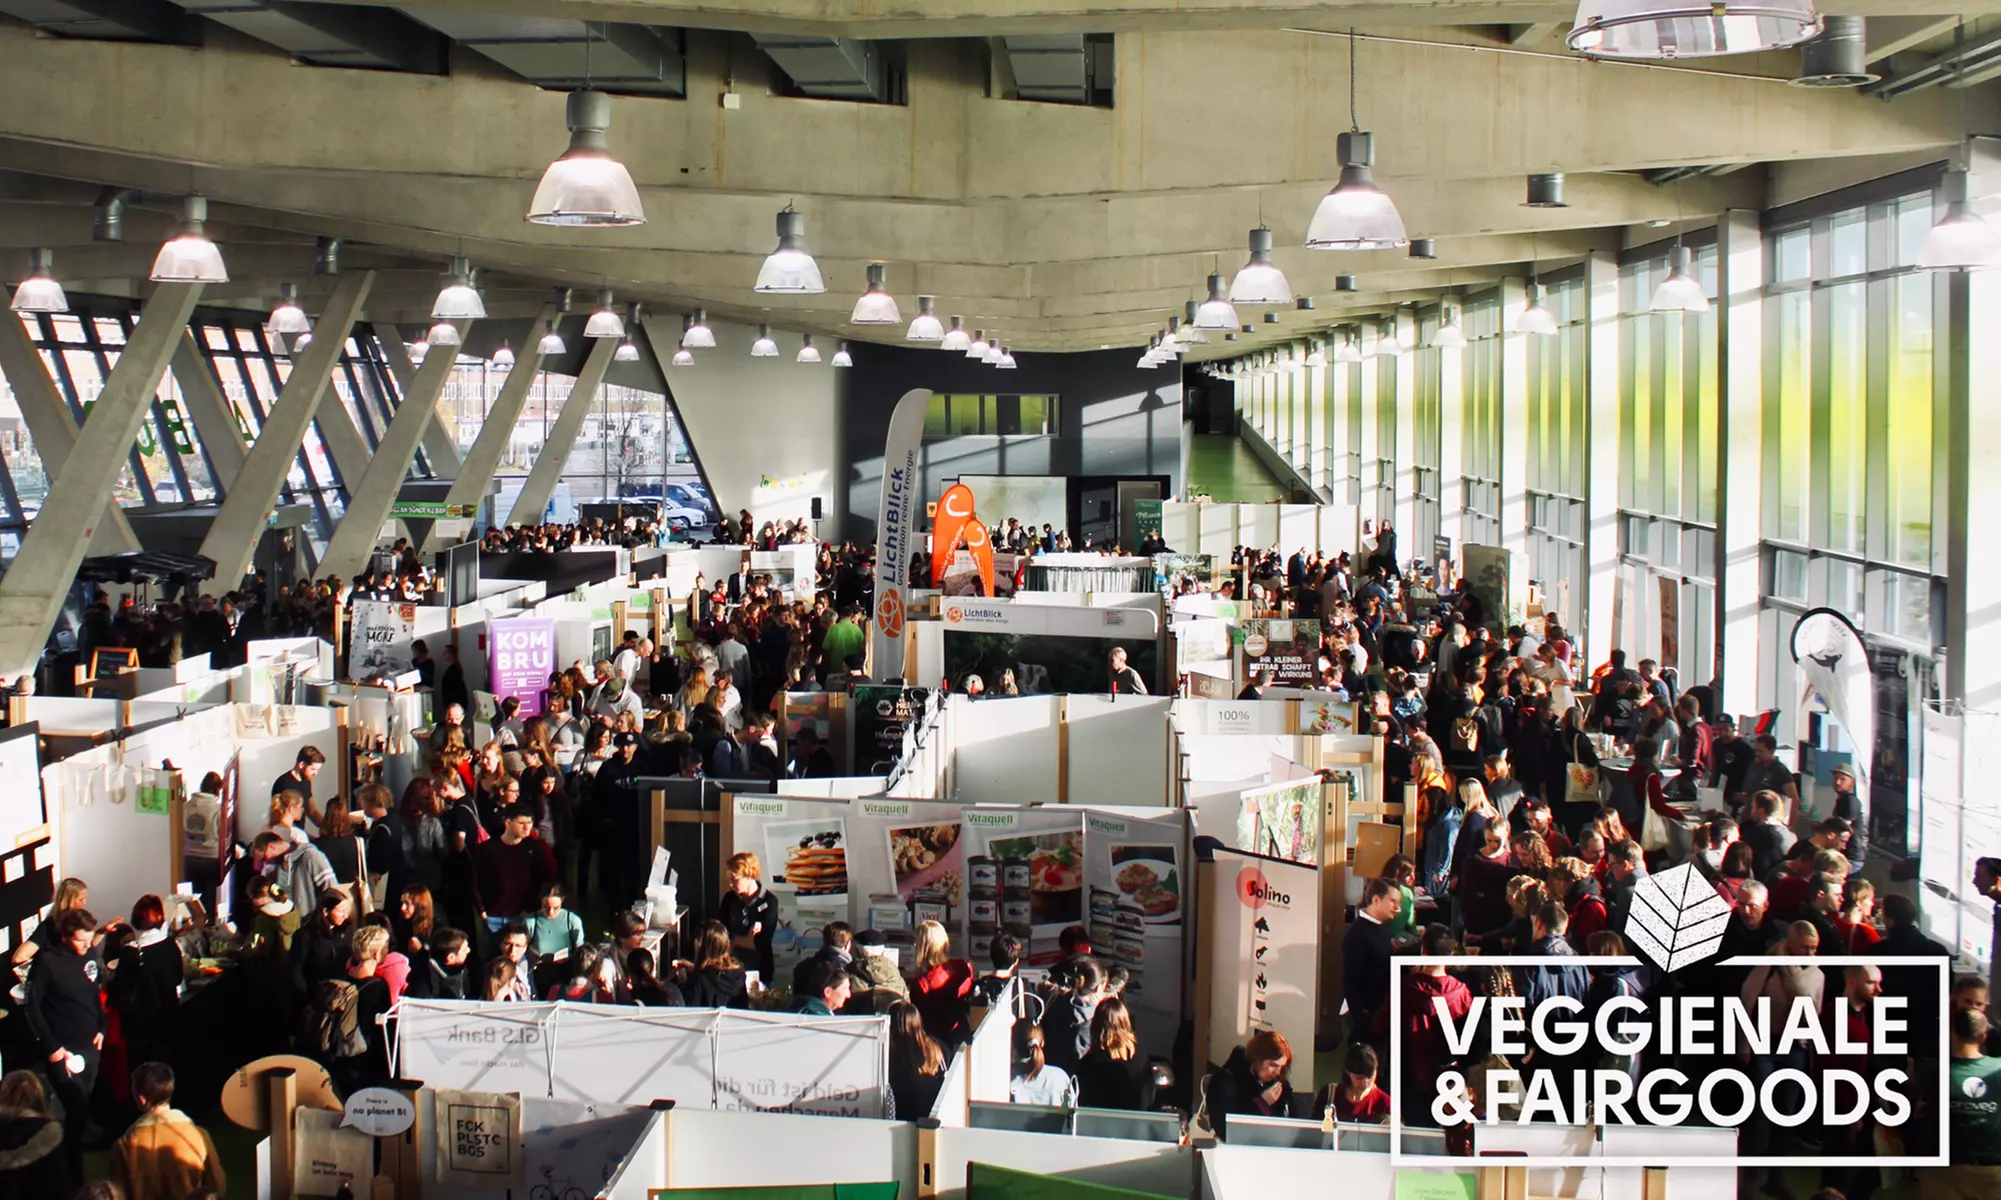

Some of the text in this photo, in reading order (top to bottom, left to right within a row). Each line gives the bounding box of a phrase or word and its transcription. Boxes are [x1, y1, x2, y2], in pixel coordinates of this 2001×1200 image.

[903, 449, 914, 490] Energie
[901, 493, 909, 522] reine
[883, 467, 903, 583] LichtBlick
[964, 609, 1002, 618] LichtBlick
[366, 631, 396, 643] MORE
[497, 630, 548, 650] KOM
[1282, 663, 1312, 671] SCHAFFT
[1219, 710, 1250, 721] 100%
[740, 802, 783, 813] Vitaquell
[864, 803, 908, 815] Vitaquell
[967, 814, 1013, 826] Vitaquell
[1088, 818, 1125, 832] Vitaquell
[1248, 880, 1291, 904] Solino
[367, 1106, 395, 1116] planet
[456, 1119, 485, 1132] FCK
[456, 1132, 501, 1146] PLSTC
